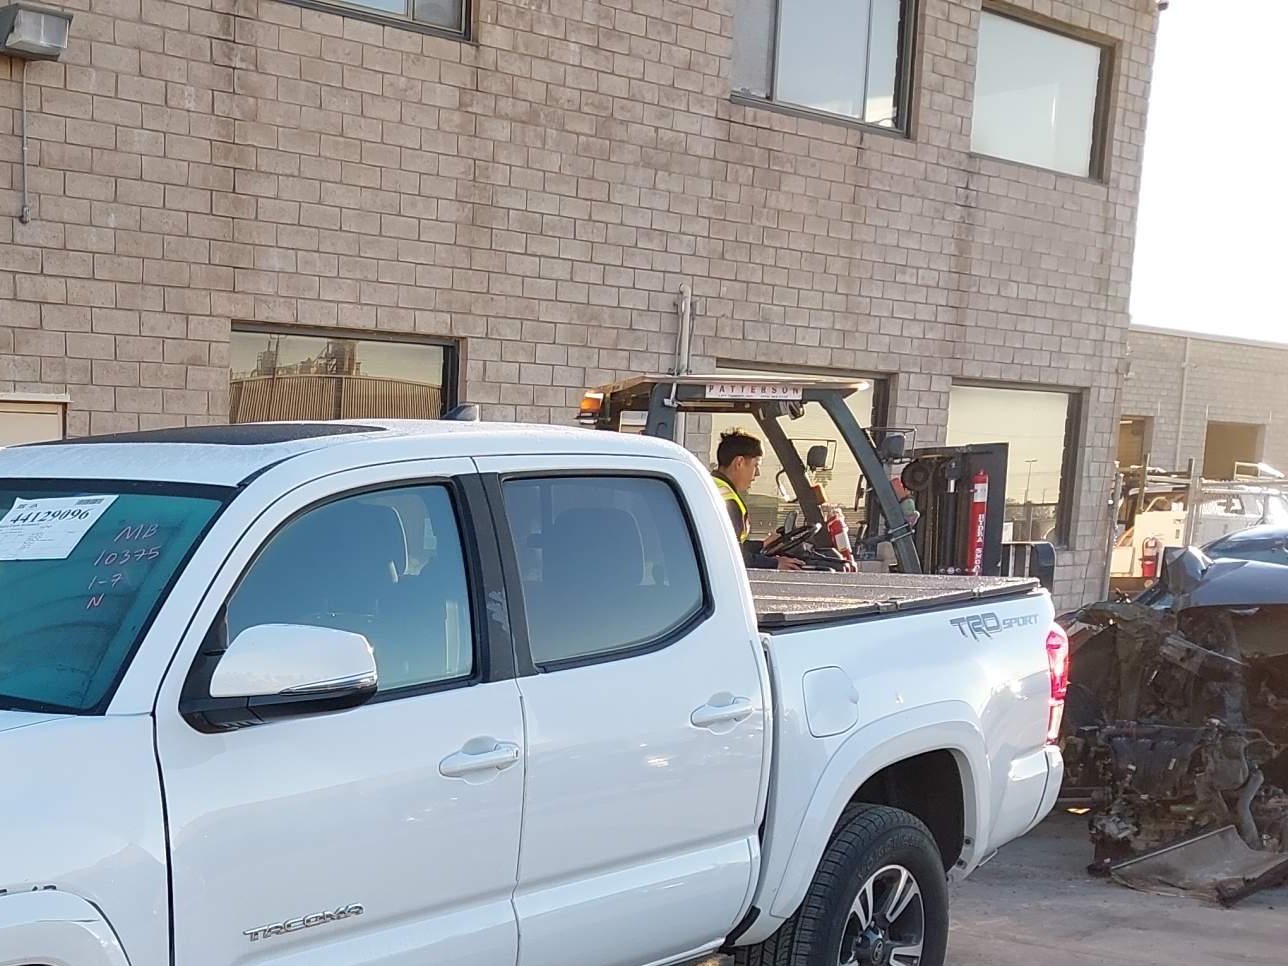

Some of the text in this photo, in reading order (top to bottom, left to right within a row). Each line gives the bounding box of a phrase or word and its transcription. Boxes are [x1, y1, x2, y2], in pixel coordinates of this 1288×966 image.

[708, 384, 799, 395] PATTERSON
[10, 508, 90, 524] 44129096
[94, 546, 161, 567] 10375
[950, 612, 1039, 642] TRD SPORT
[242, 903, 365, 942] TACOMA
